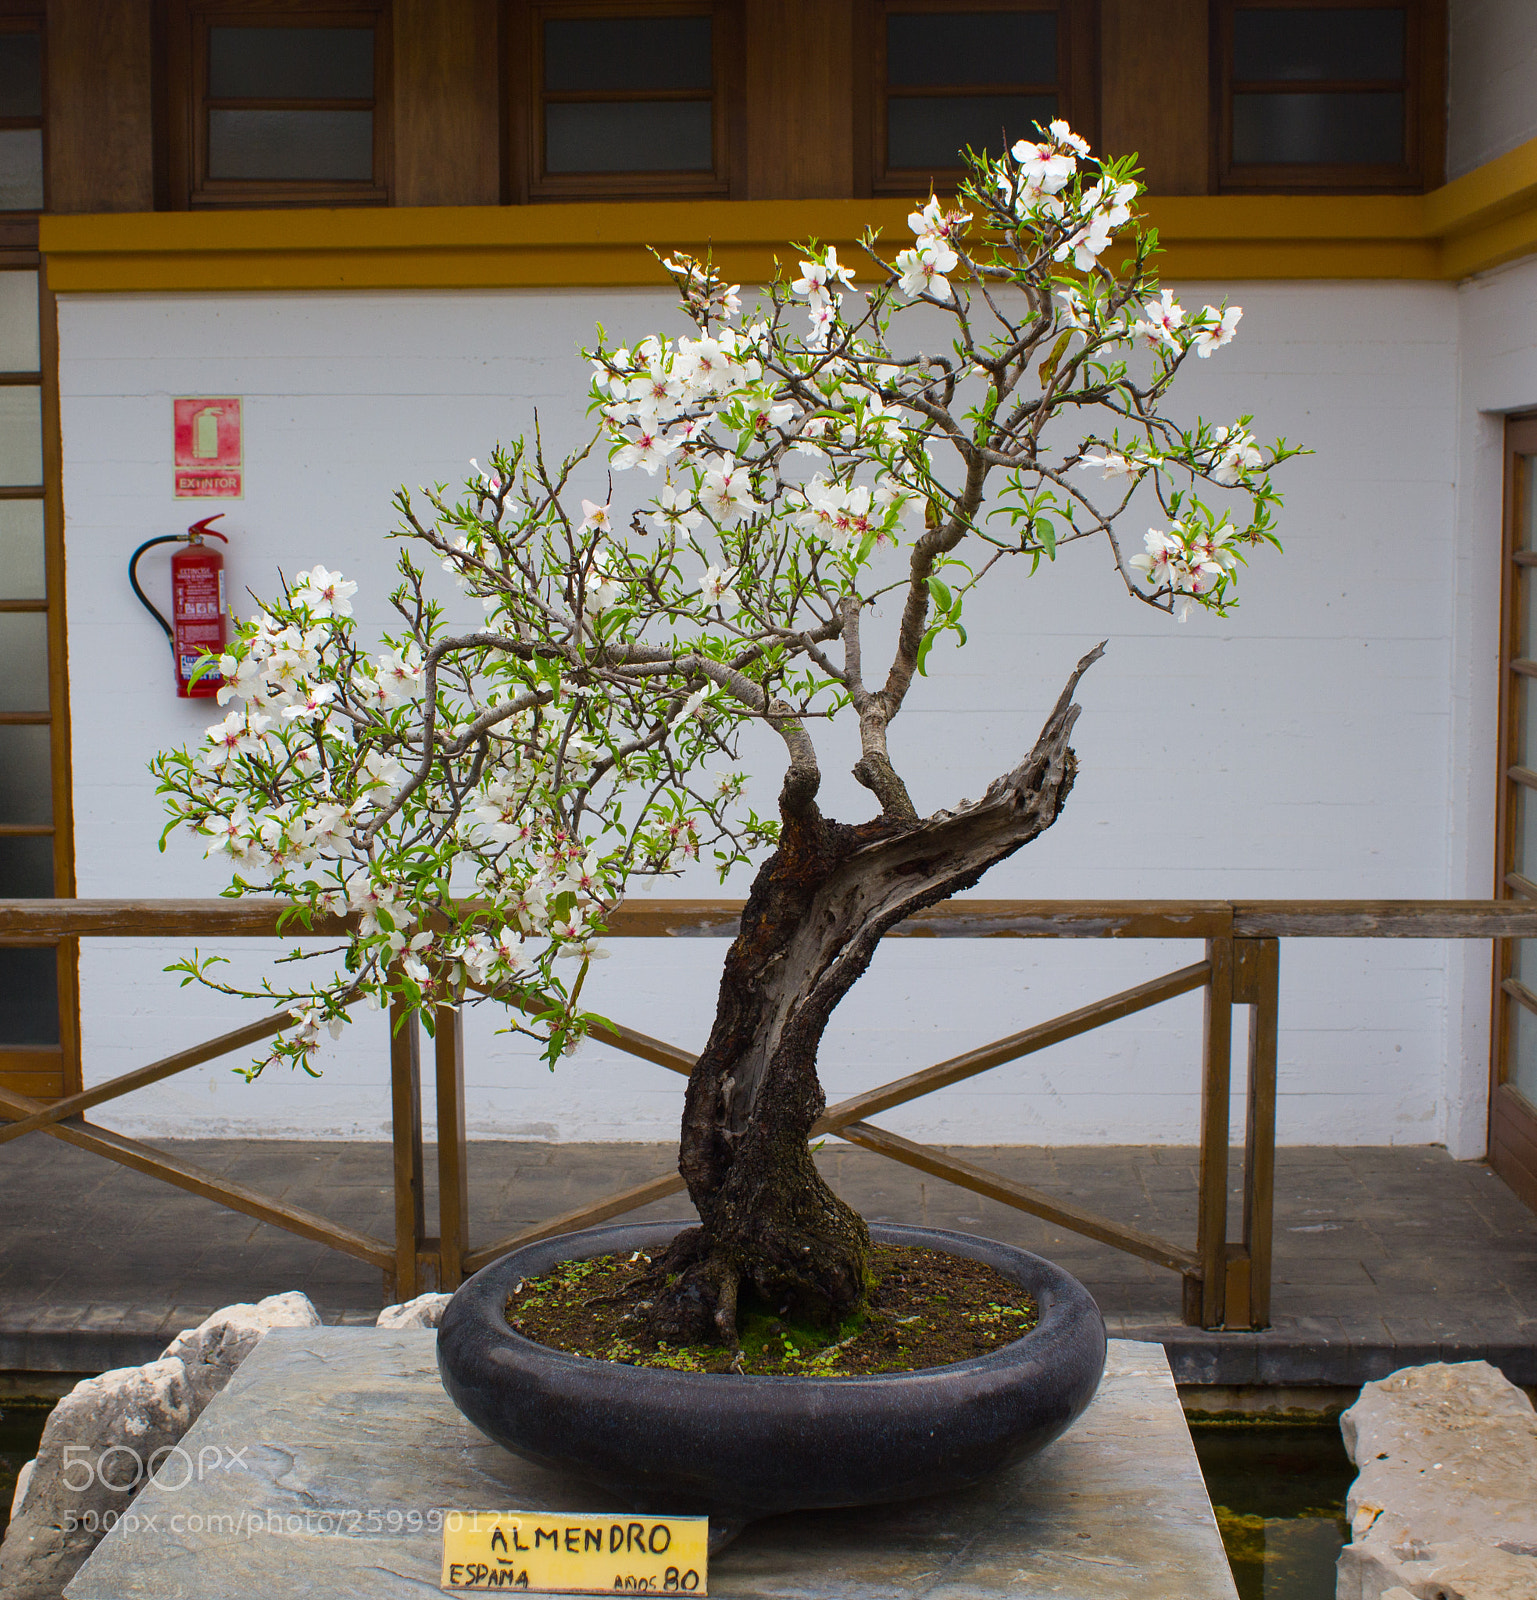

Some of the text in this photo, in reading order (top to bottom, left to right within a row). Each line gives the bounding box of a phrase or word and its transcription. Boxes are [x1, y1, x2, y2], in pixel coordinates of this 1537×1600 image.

[179, 478, 237, 489] EXTINTOR
[491, 1522, 672, 1555] ALMENDRO
[450, 1557, 529, 1588] ESPAÑA
[663, 1565, 699, 1591] 80
